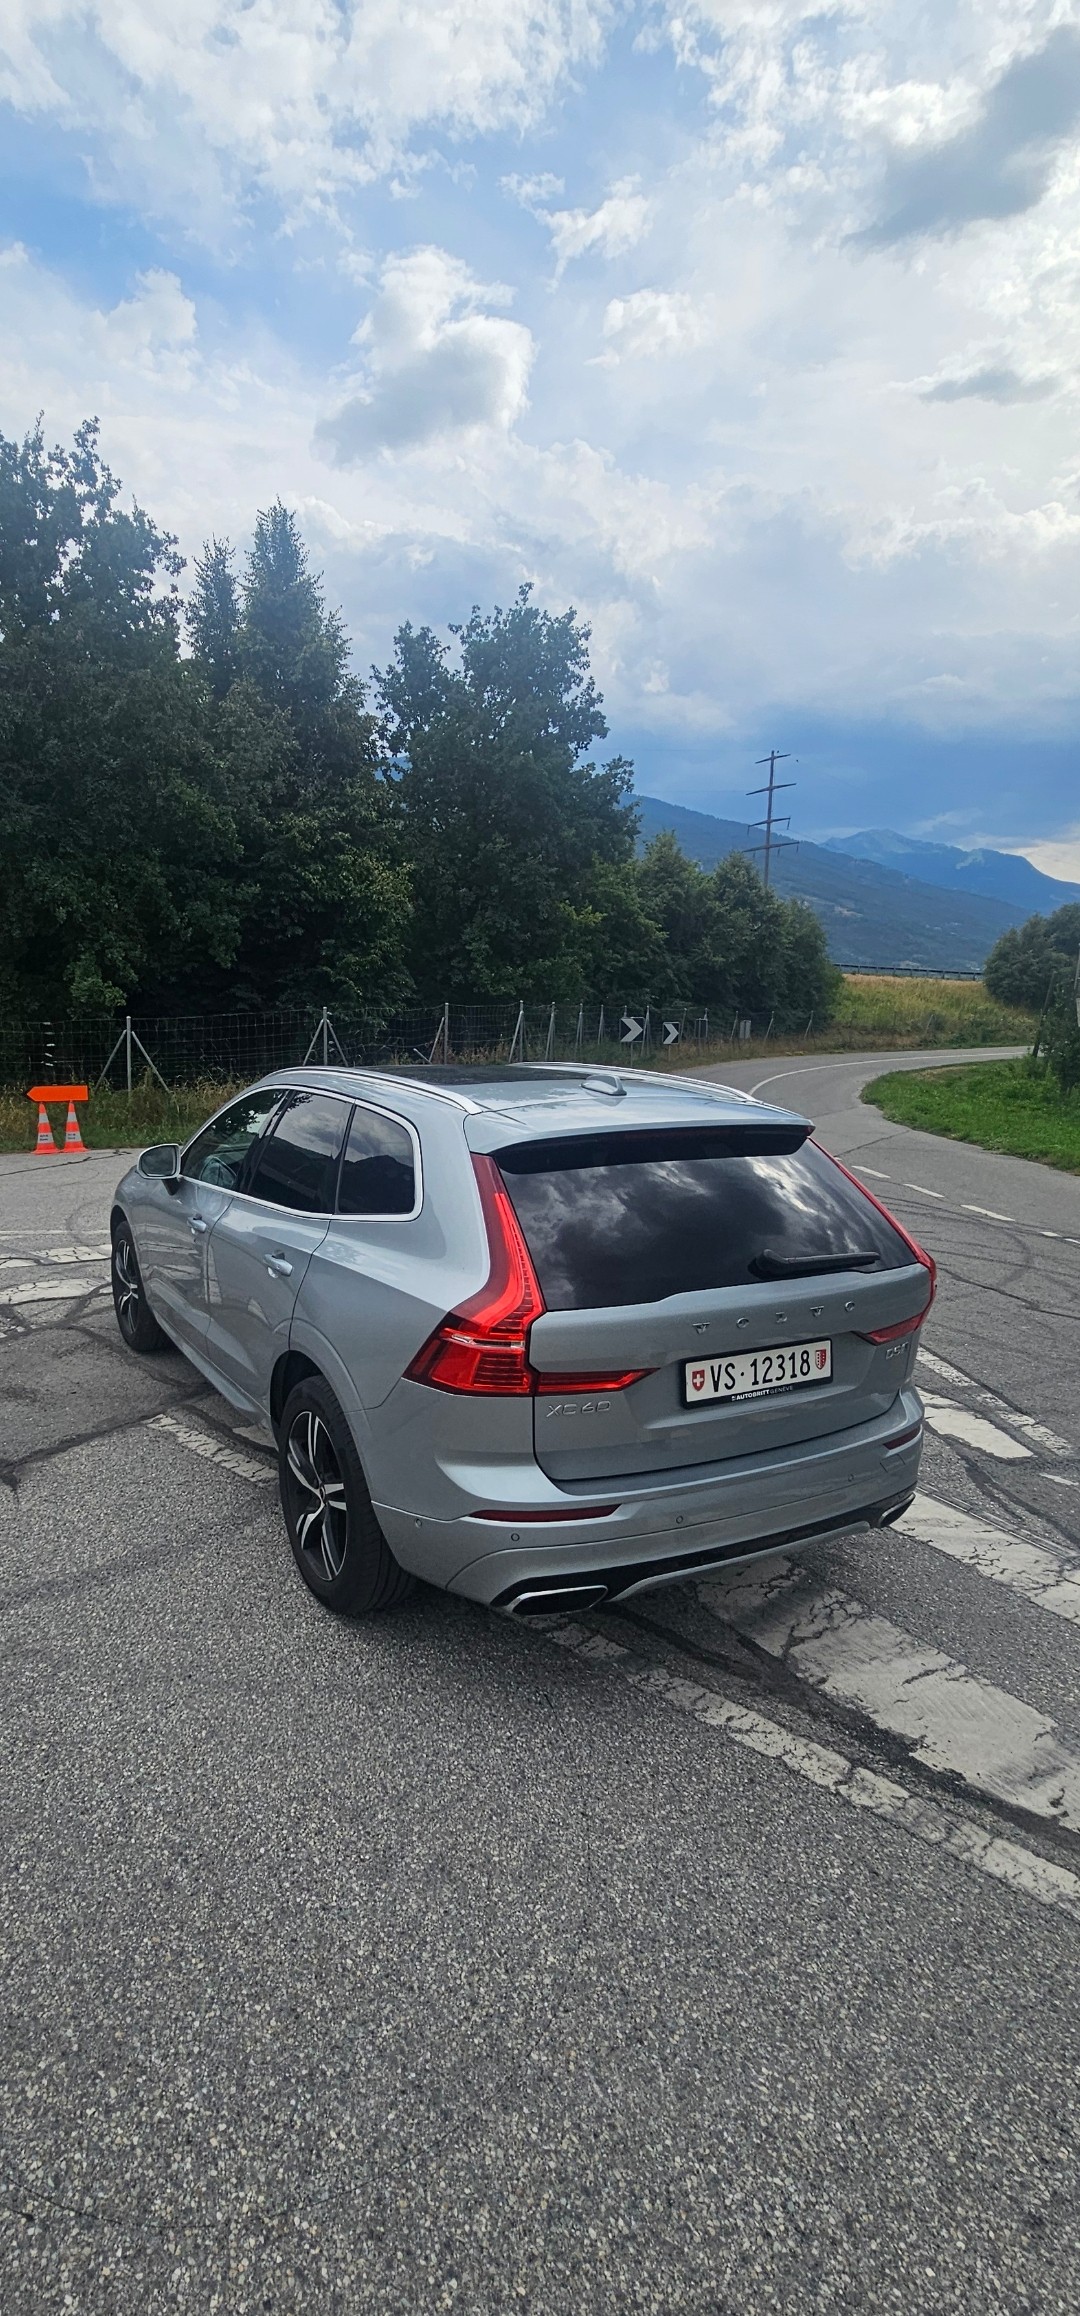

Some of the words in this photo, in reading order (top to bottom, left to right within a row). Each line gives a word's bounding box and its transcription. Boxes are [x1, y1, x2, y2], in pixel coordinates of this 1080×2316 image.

[692, 1301, 856, 1335] VOLVO
[736, 1389, 770, 1400] AUTOBRITT
[546, 1400, 611, 1418] XC60
